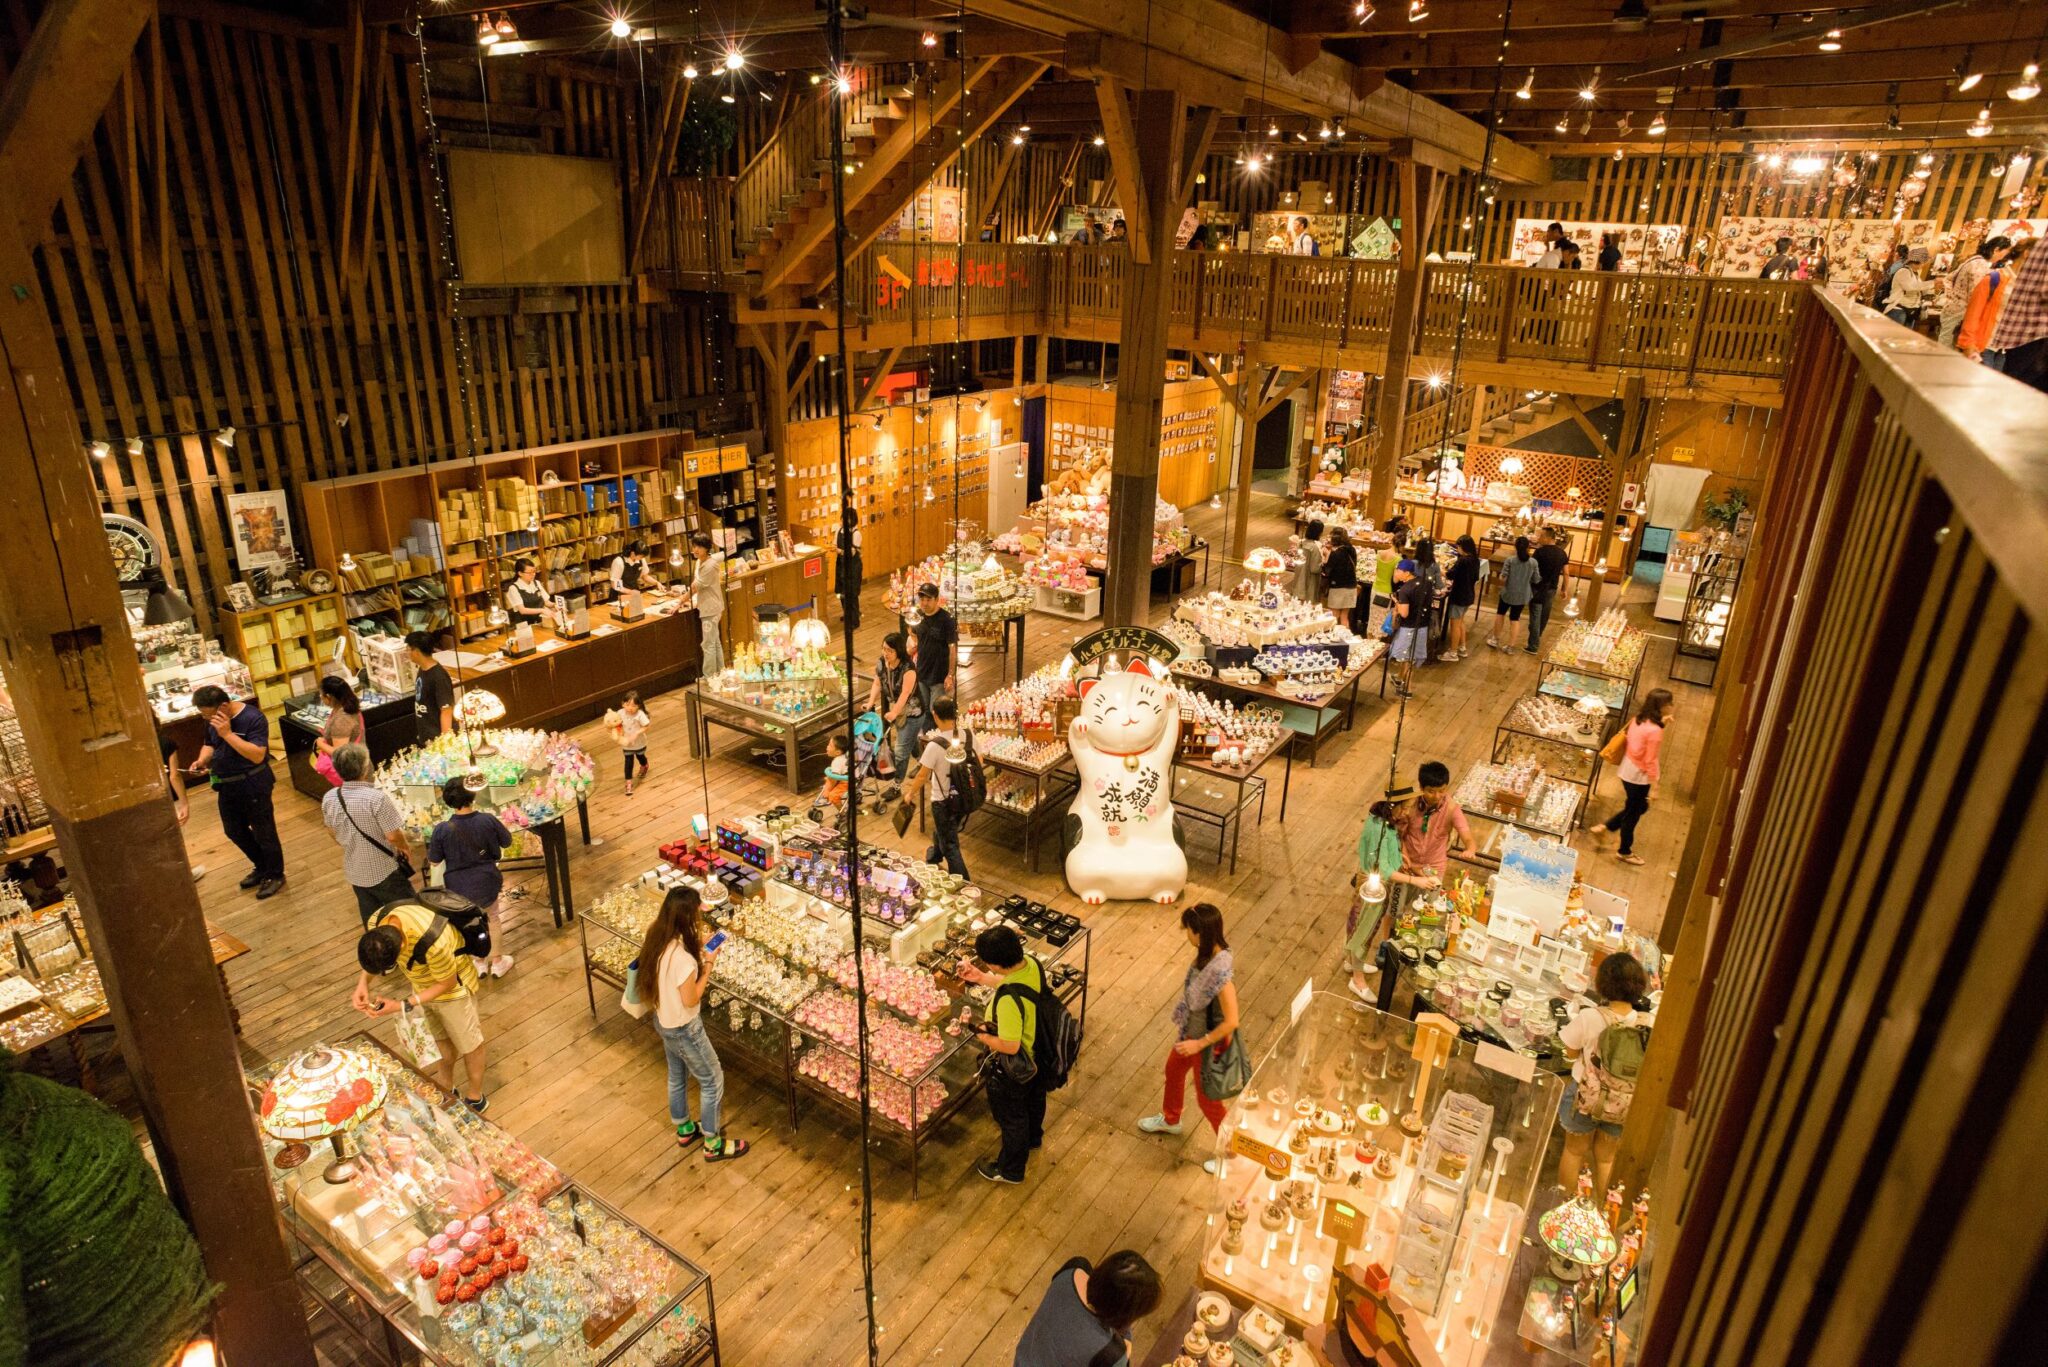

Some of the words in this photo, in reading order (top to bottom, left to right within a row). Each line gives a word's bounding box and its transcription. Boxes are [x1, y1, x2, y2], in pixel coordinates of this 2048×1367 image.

[877, 276, 903, 311] 3F
[701, 450, 742, 466] CASHIER
[557, 597, 564, 607] B
[1102, 628, 1148, 640] ようこそ
[1079, 635, 1173, 663] 小樽オルゴール堂
[1099, 781, 1127, 822] 成就
[1124, 766, 1160, 813] 満願
